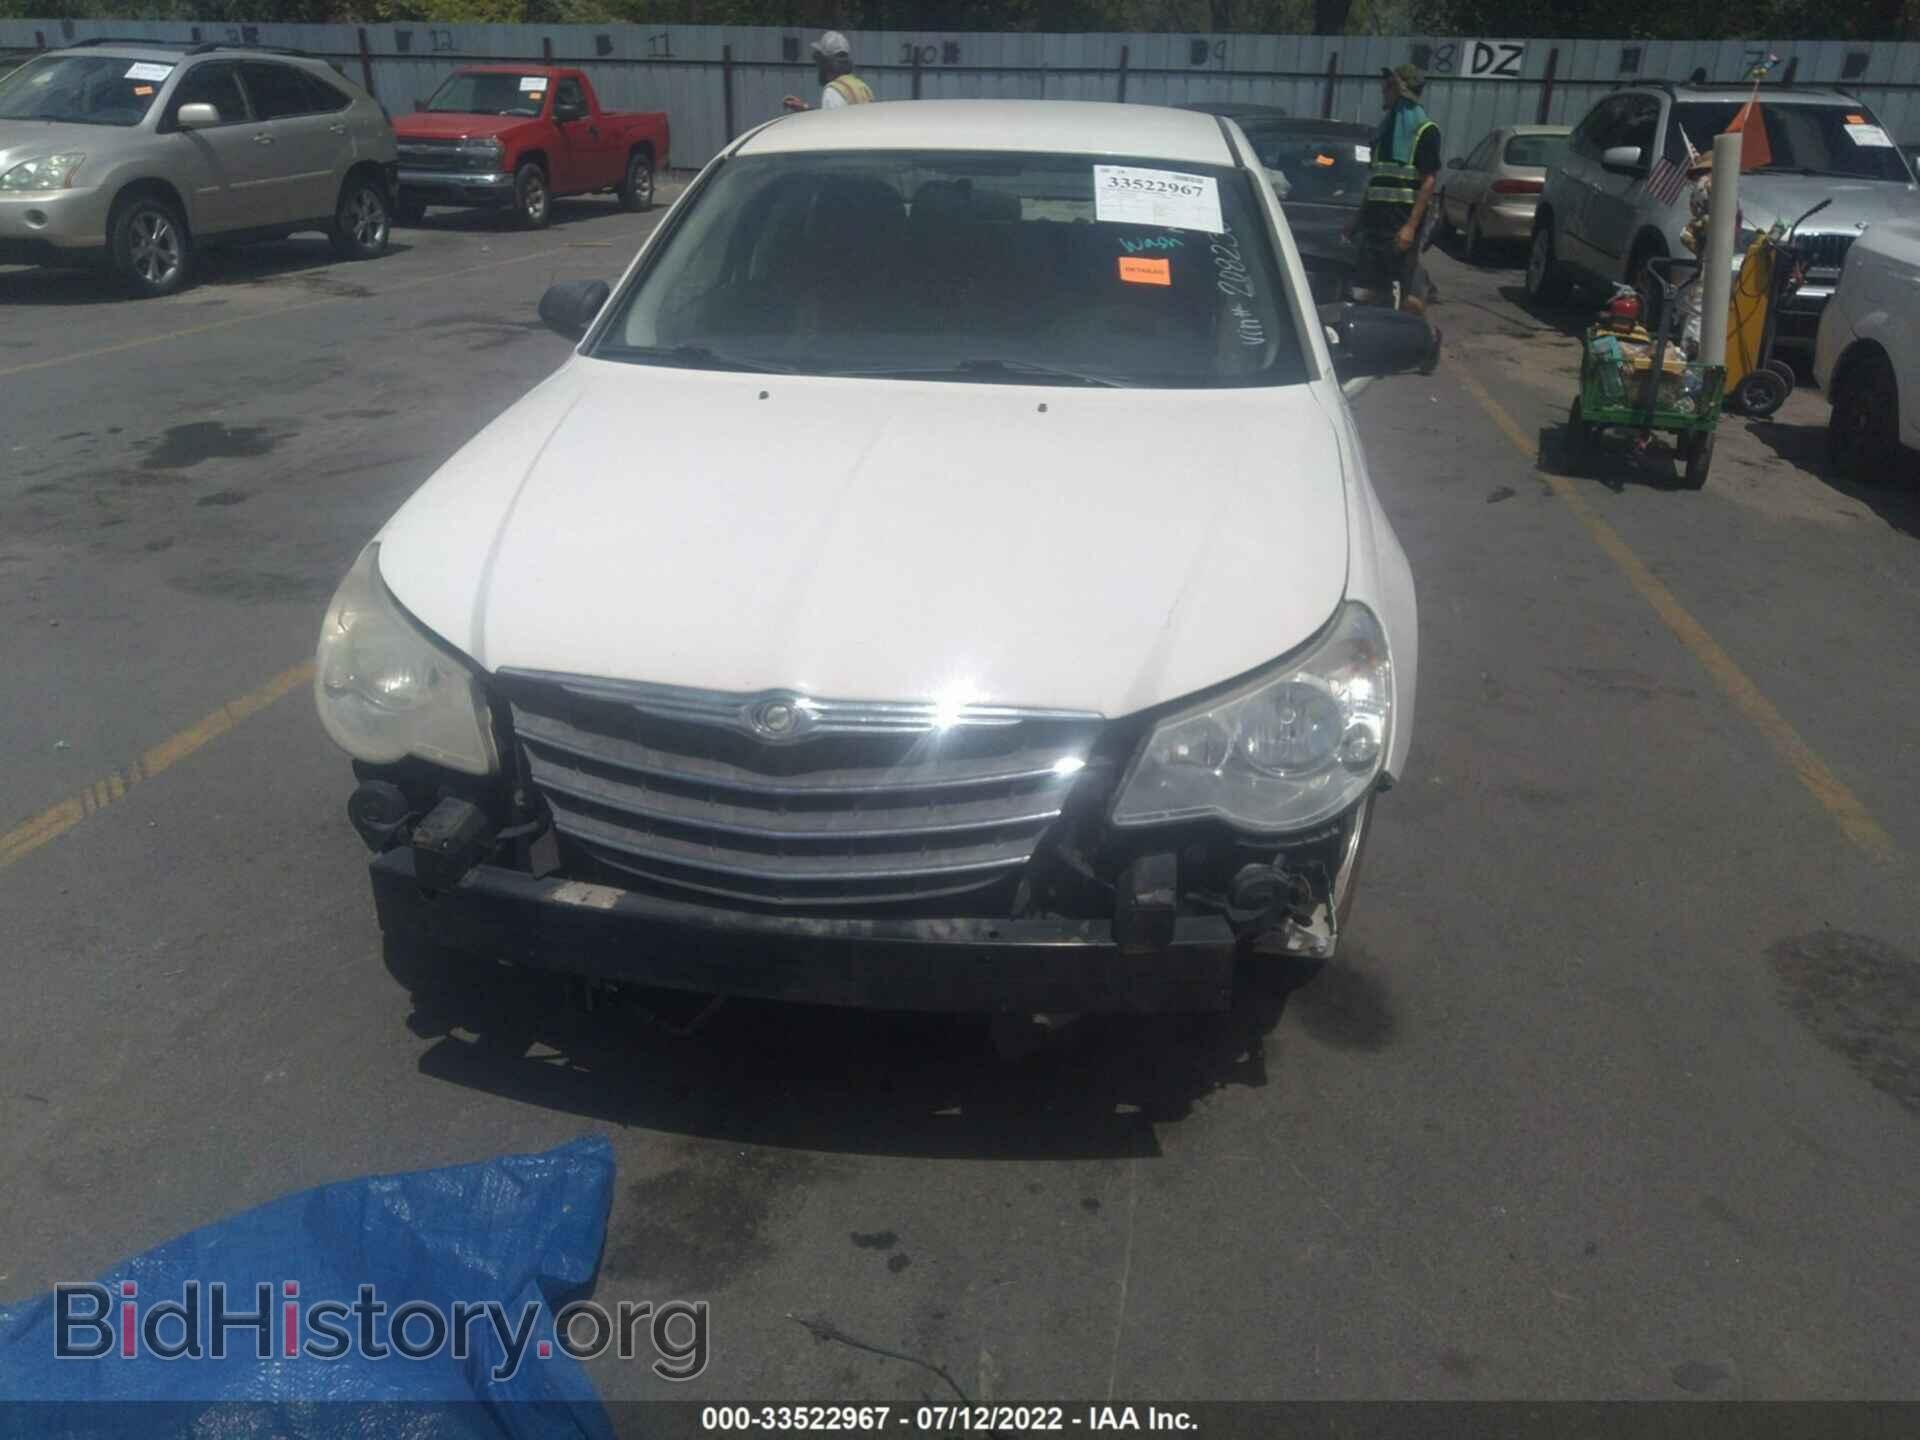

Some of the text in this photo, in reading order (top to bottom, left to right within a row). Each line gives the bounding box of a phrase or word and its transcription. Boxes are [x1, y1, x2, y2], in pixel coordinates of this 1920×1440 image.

[901, 42, 938, 64] 10
[1435, 43, 1455, 73] 8
[1471, 41, 1524, 77] DZ
[1107, 176, 1204, 197] 33522967
